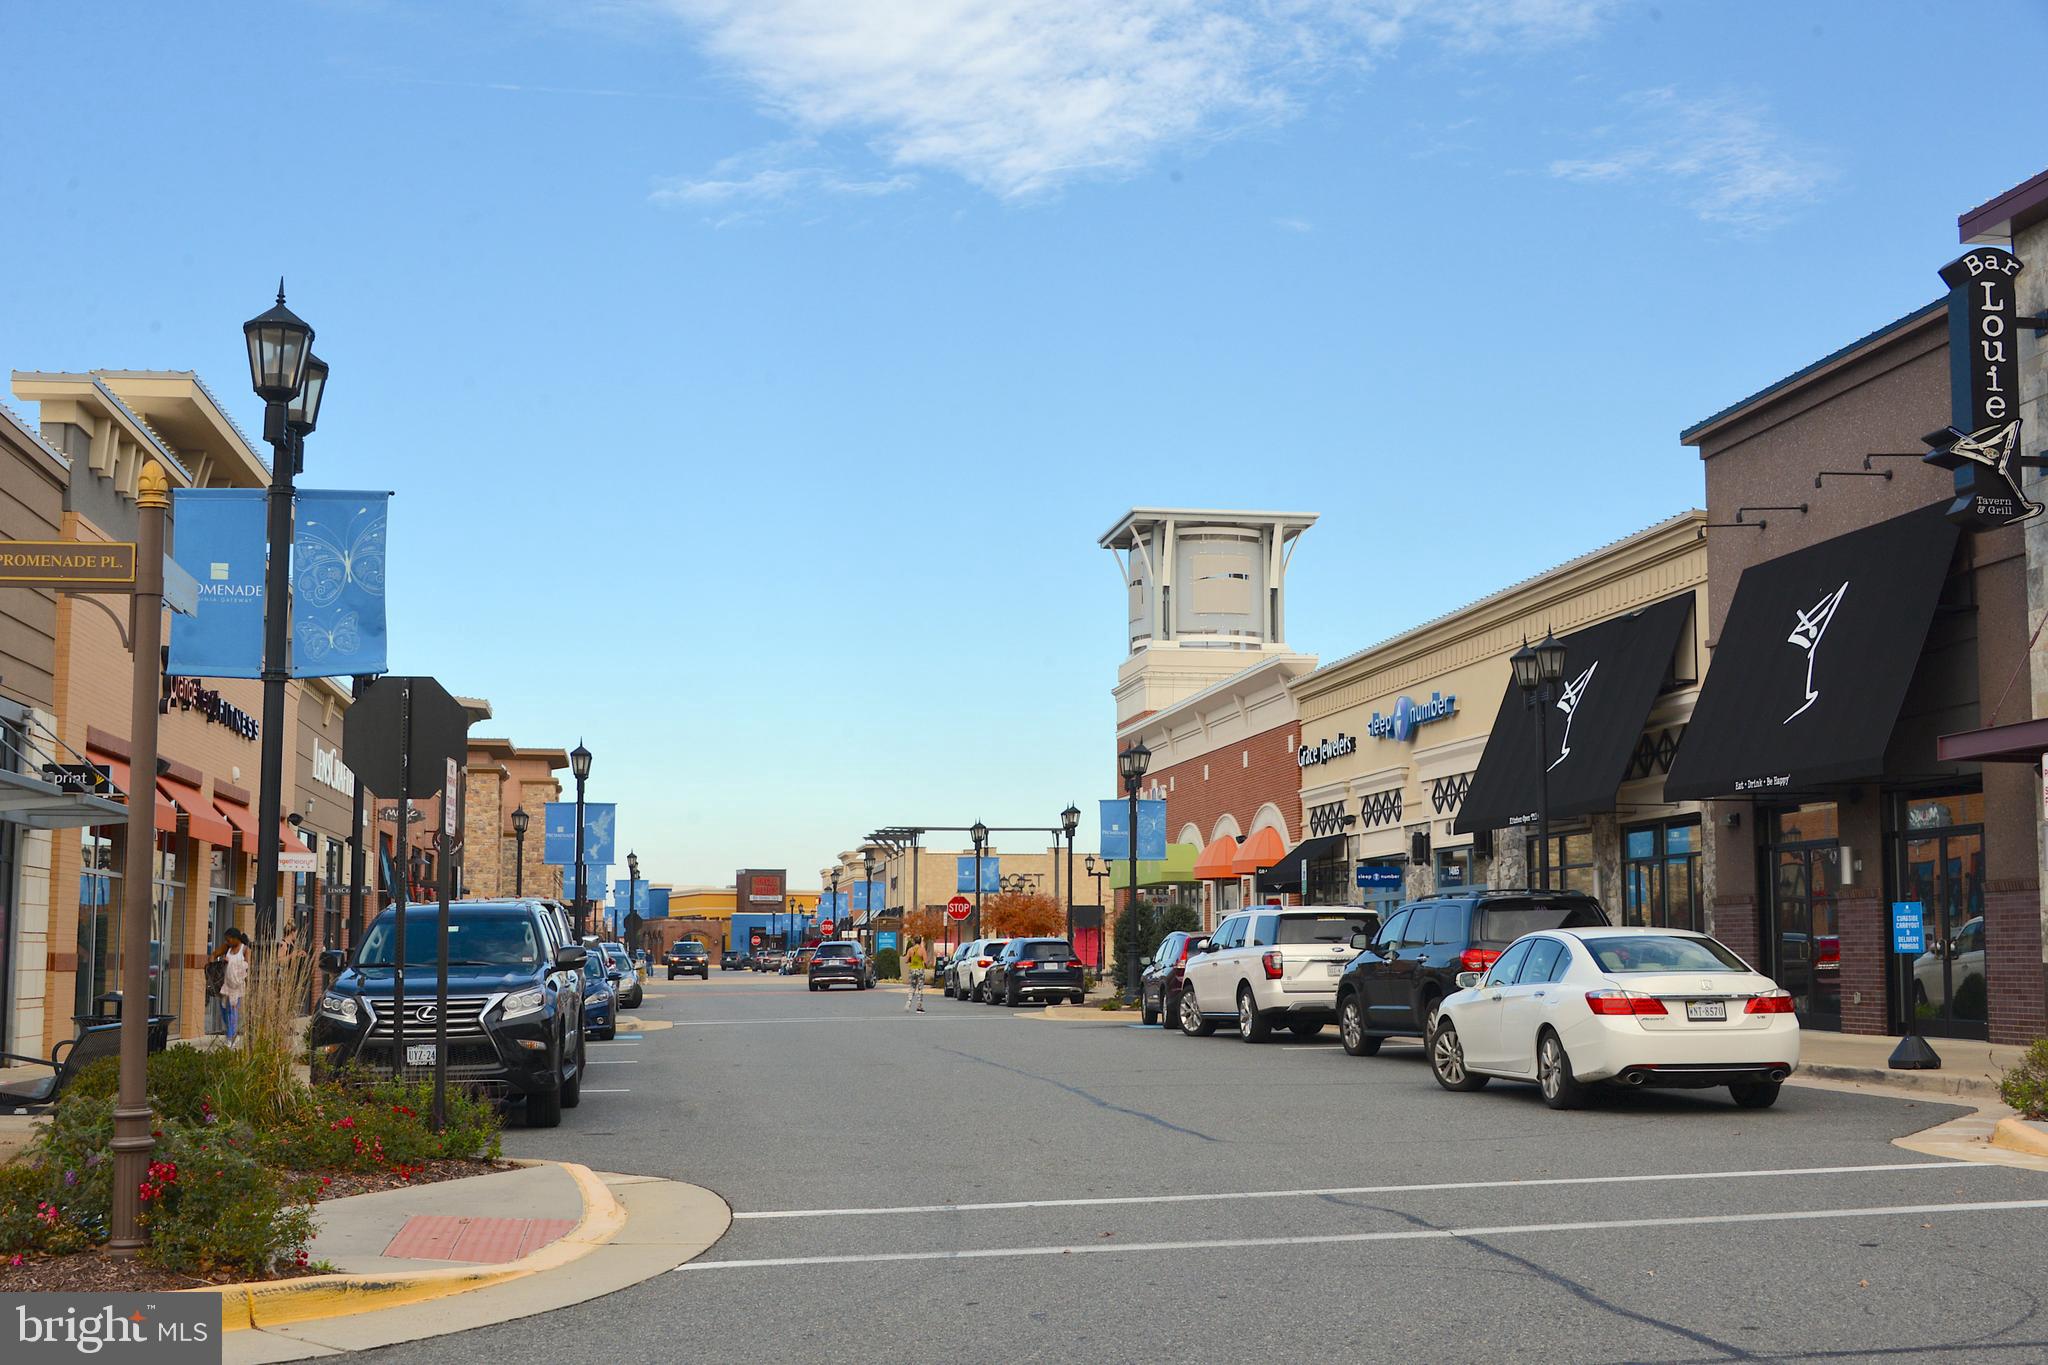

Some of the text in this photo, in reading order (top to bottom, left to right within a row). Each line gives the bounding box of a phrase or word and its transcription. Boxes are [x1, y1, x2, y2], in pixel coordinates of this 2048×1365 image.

[1963, 254, 2020, 278] Bar
[1980, 281, 2006, 419] Louie
[1976, 496, 2012, 506] Tavern
[1977, 505, 2012, 515] & Grill
[101, 556, 123, 568] PL.
[198, 583, 262, 597] OMENADE
[220, 698, 259, 741] FITNESS
[1367, 692, 1456, 739] sleep number
[1297, 743, 1318, 767] Grace
[1735, 781, 1744, 790] Eat
[948, 903, 970, 913] STOP
[408, 1049, 437, 1062] UYZ-24
